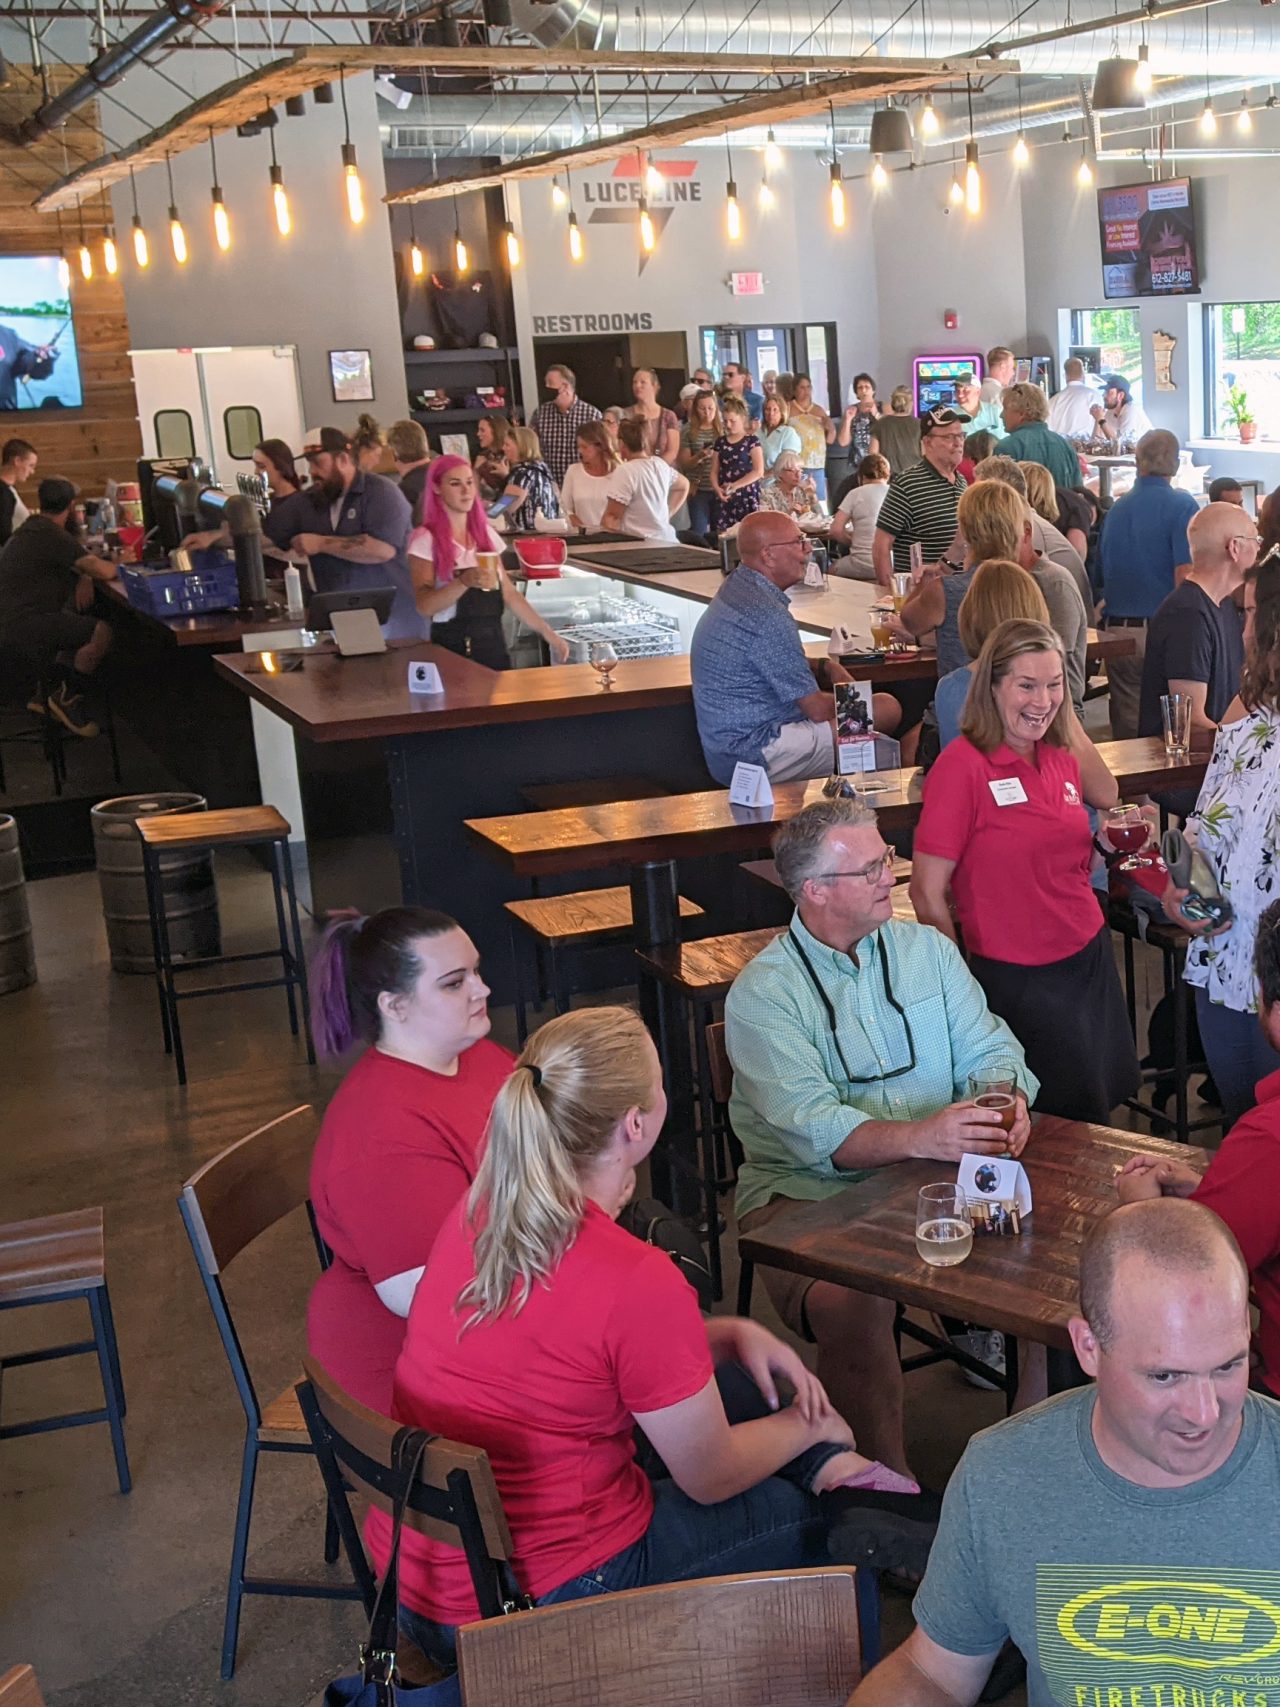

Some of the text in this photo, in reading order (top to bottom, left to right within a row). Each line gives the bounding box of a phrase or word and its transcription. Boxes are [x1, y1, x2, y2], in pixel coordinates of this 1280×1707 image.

[583, 182, 641, 202] LUCE
[532, 312, 653, 333] RESTROOMS
[1095, 1602, 1250, 1643] E-ONE
[1074, 1684, 1268, 1707] FIRETRUCKS
